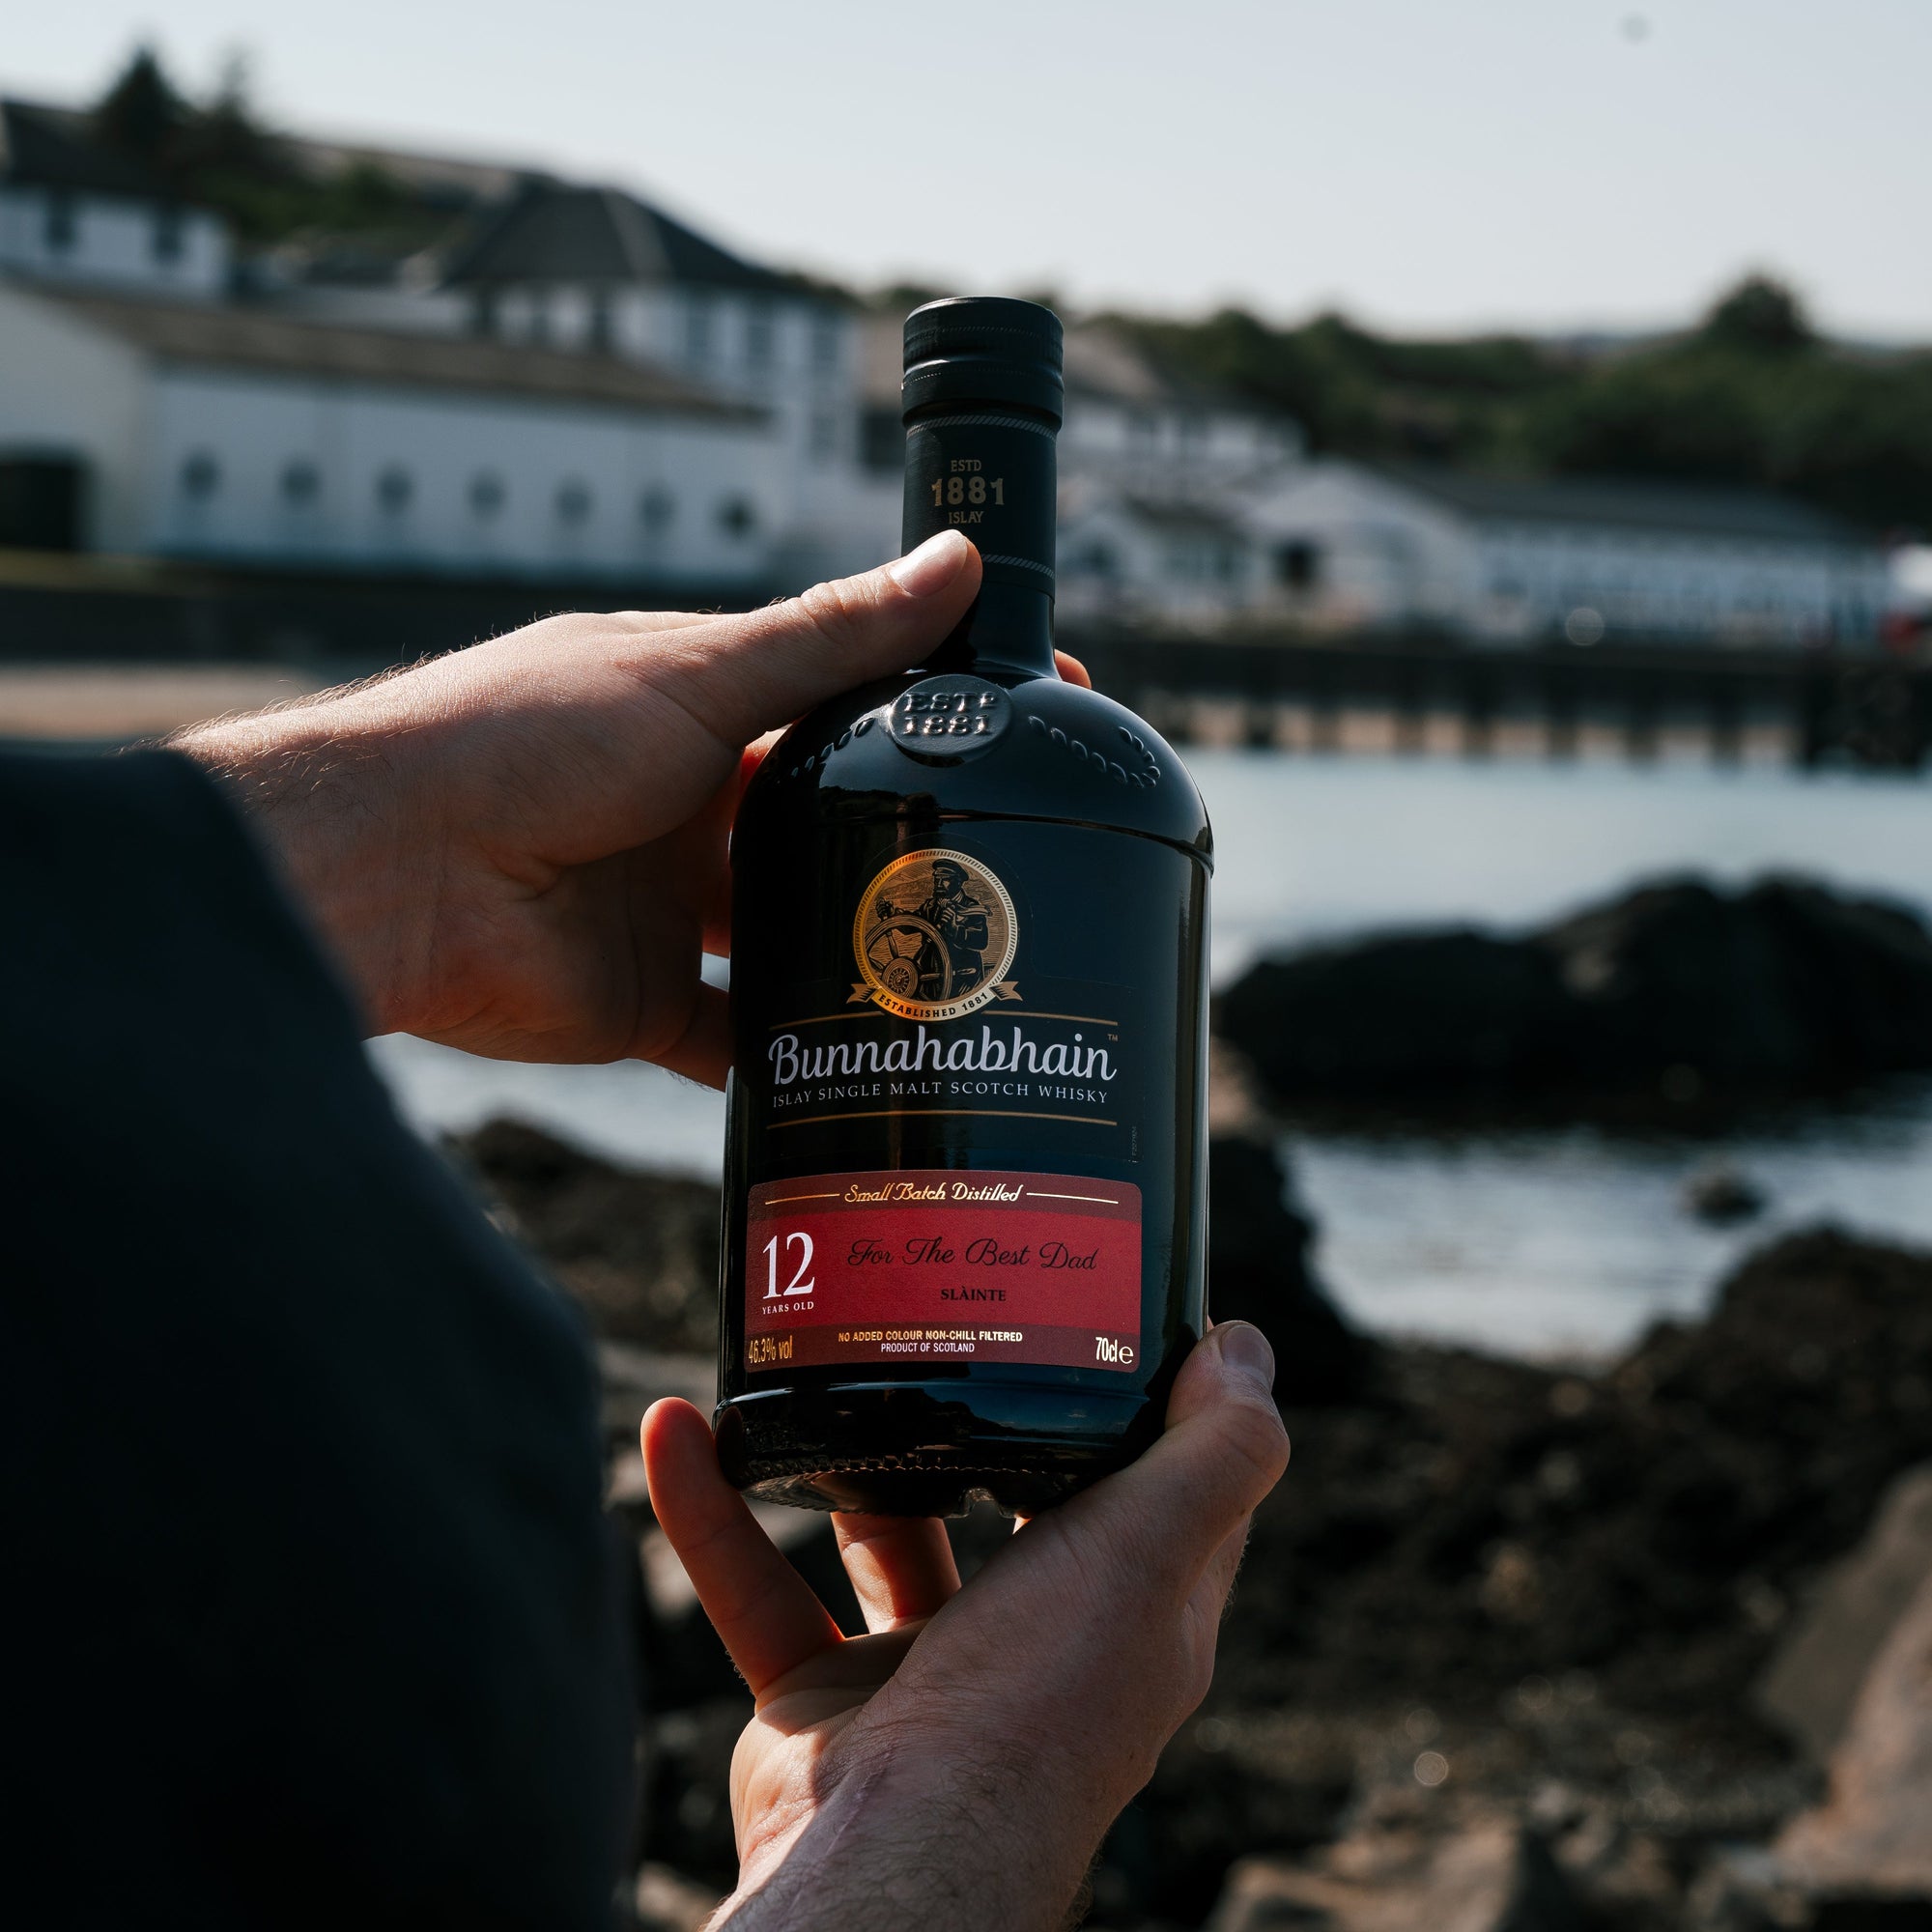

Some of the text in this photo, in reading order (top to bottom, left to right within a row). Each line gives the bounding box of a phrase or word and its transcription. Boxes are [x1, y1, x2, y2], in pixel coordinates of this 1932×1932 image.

[951, 459, 982, 472] ESTD
[930, 476, 1006, 507] 1881
[948, 511, 984, 525] ISLAY
[901, 715, 989, 735] 1881
[878, 991, 988, 1018] ESTABLISHED 1881
[768, 1025, 1118, 1085] Bunnahabhain
[773, 1081, 1108, 1108] ISLAY SINGLE MALT SCOTCH WHISKY
[844, 1181, 1024, 1203] Small Batch Distilled
[847, 1236, 1099, 1270] For The Best Dad
[762, 1232, 815, 1300] 12
[940, 1286, 1007, 1302] SLÀINTE
[762, 1300, 815, 1315] YEARS OLD
[838, 1330, 1023, 1343] NO ADDED COLOUR NON-CHILL FILTERED
[880, 1342, 975, 1353] PRODUCT OF SCOTLAND
[748, 1335, 793, 1364] 46.3% vol
